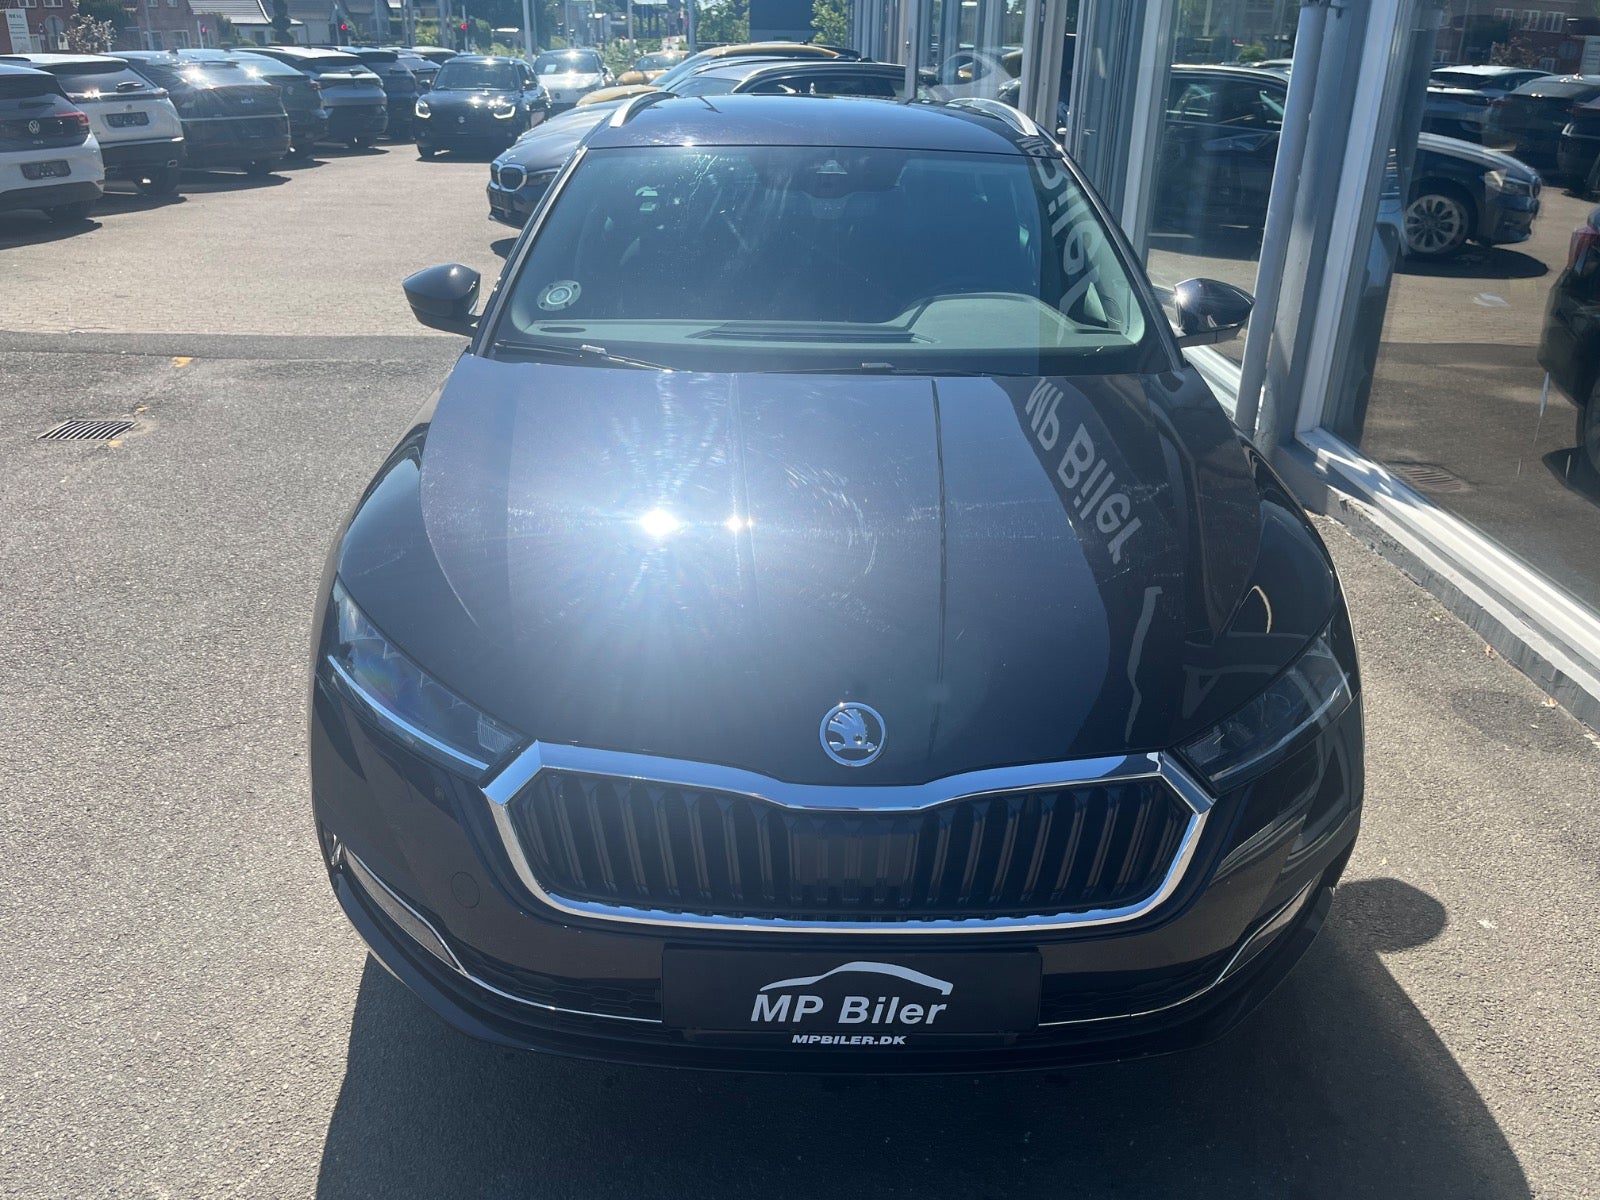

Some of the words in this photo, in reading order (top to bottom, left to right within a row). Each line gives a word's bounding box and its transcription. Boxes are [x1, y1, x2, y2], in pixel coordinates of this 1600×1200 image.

[750, 994, 824, 1023] MP
[838, 996, 947, 1025] Biler
[792, 1034, 907, 1046] MPBILER.DK
